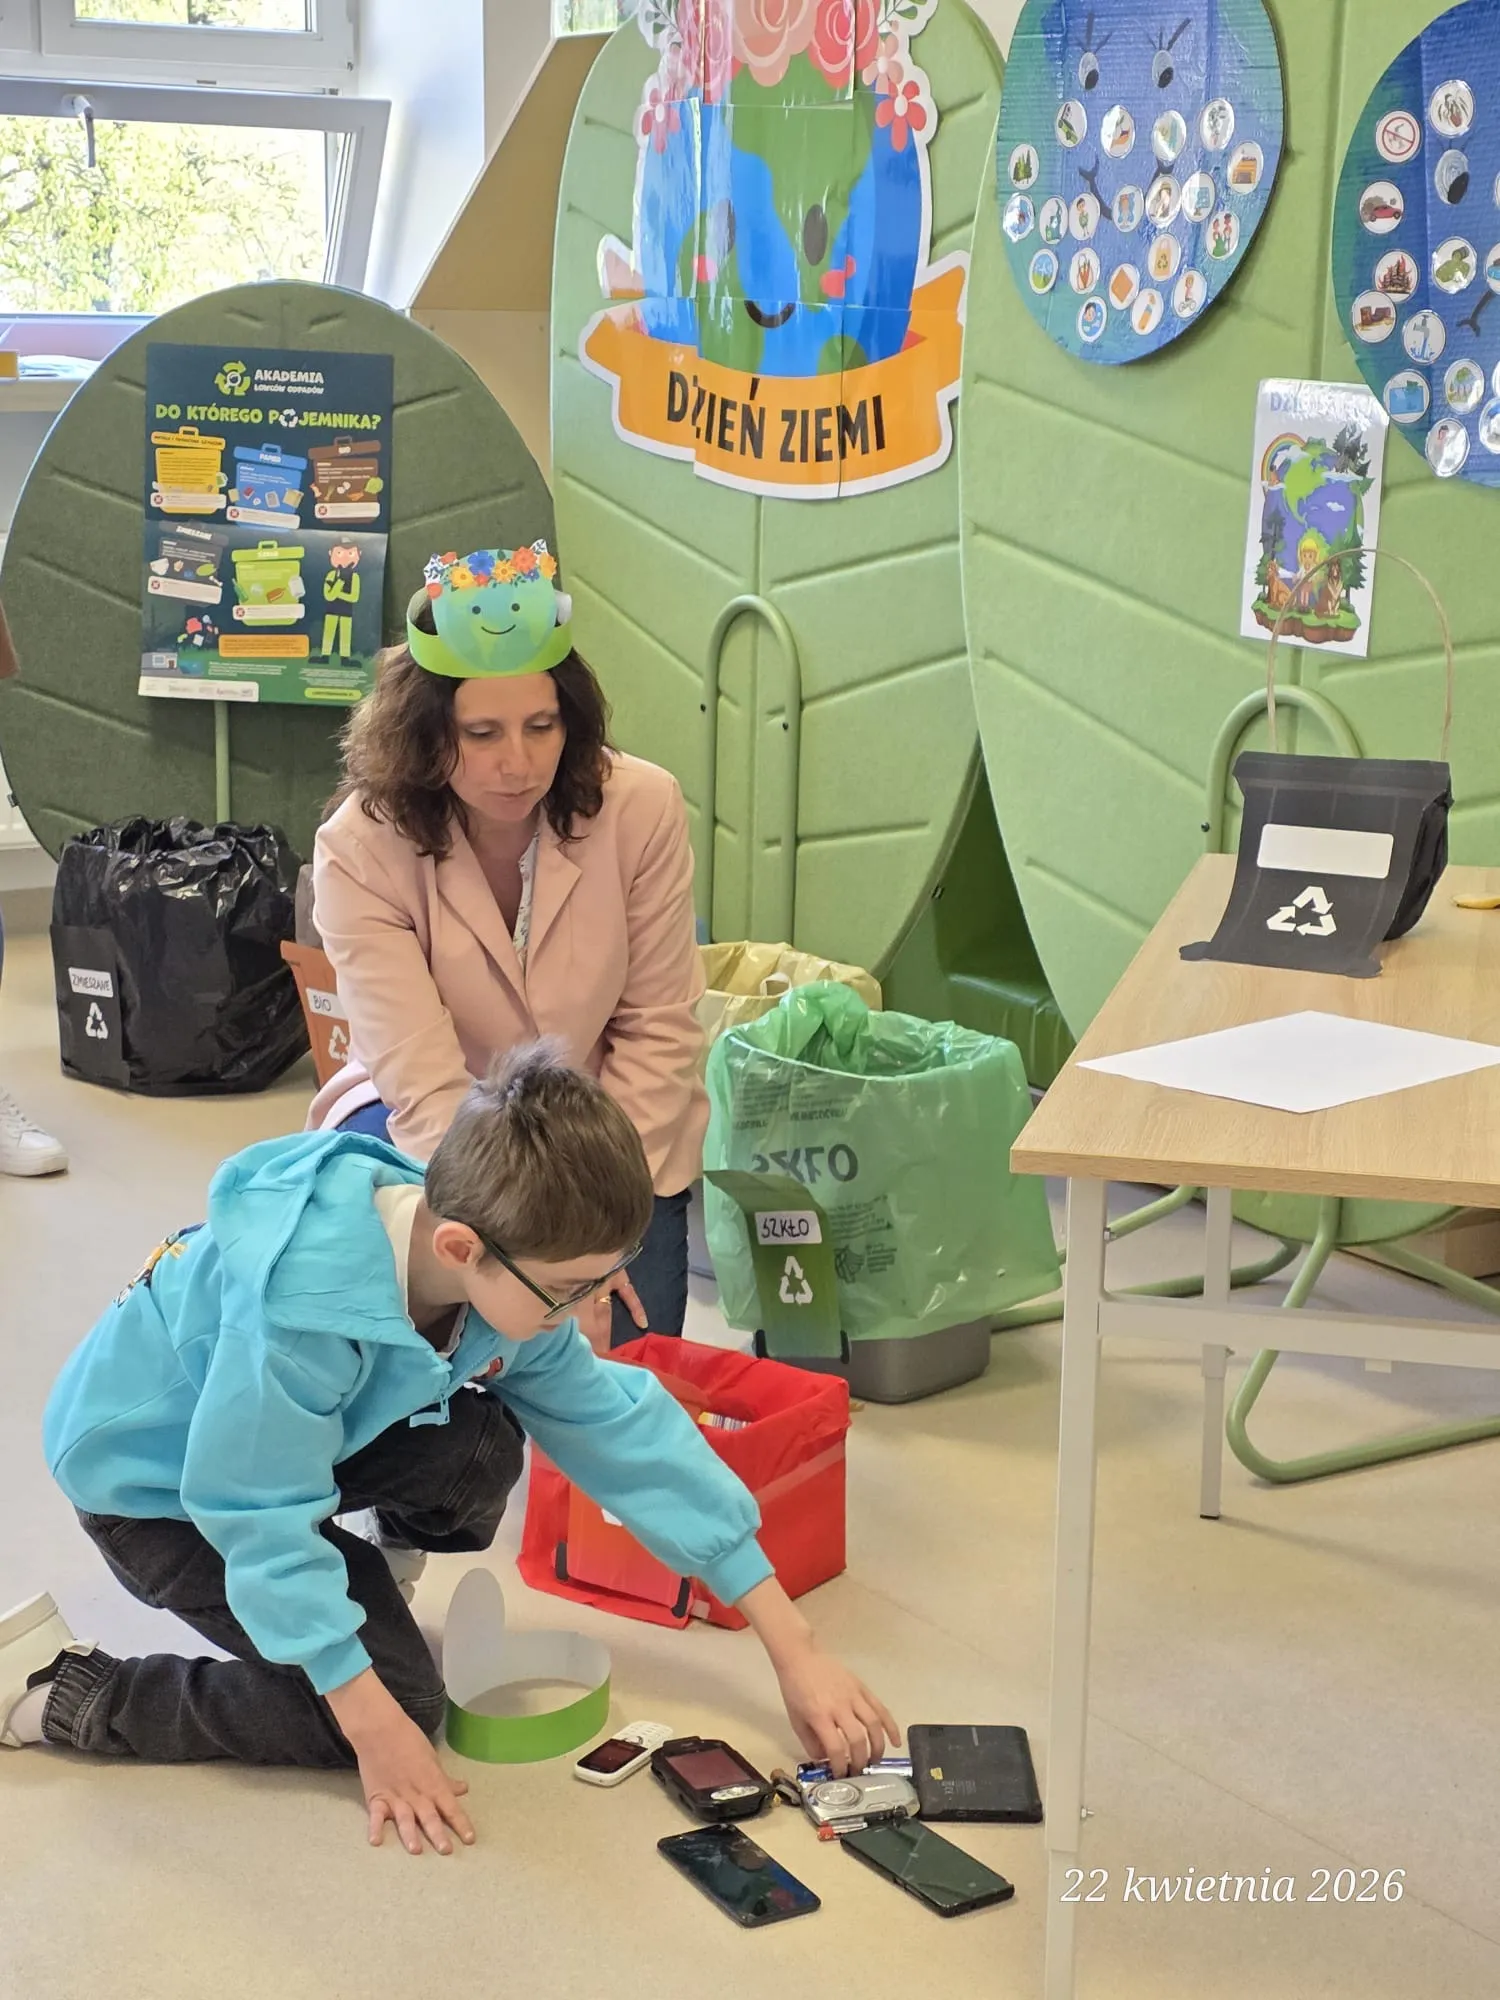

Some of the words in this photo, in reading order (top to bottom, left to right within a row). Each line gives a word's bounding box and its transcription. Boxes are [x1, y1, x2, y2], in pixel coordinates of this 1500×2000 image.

[254, 369, 324, 384] AKADEMIA
[155, 404, 180, 419] DO
[187, 402, 263, 424] KTÓREGO
[667, 370, 766, 459] DZIEŃ
[780, 394, 886, 463] ZIEMI
[313, 994, 332, 1012] BIO
[761, 1217, 810, 1239] SZKŁO
